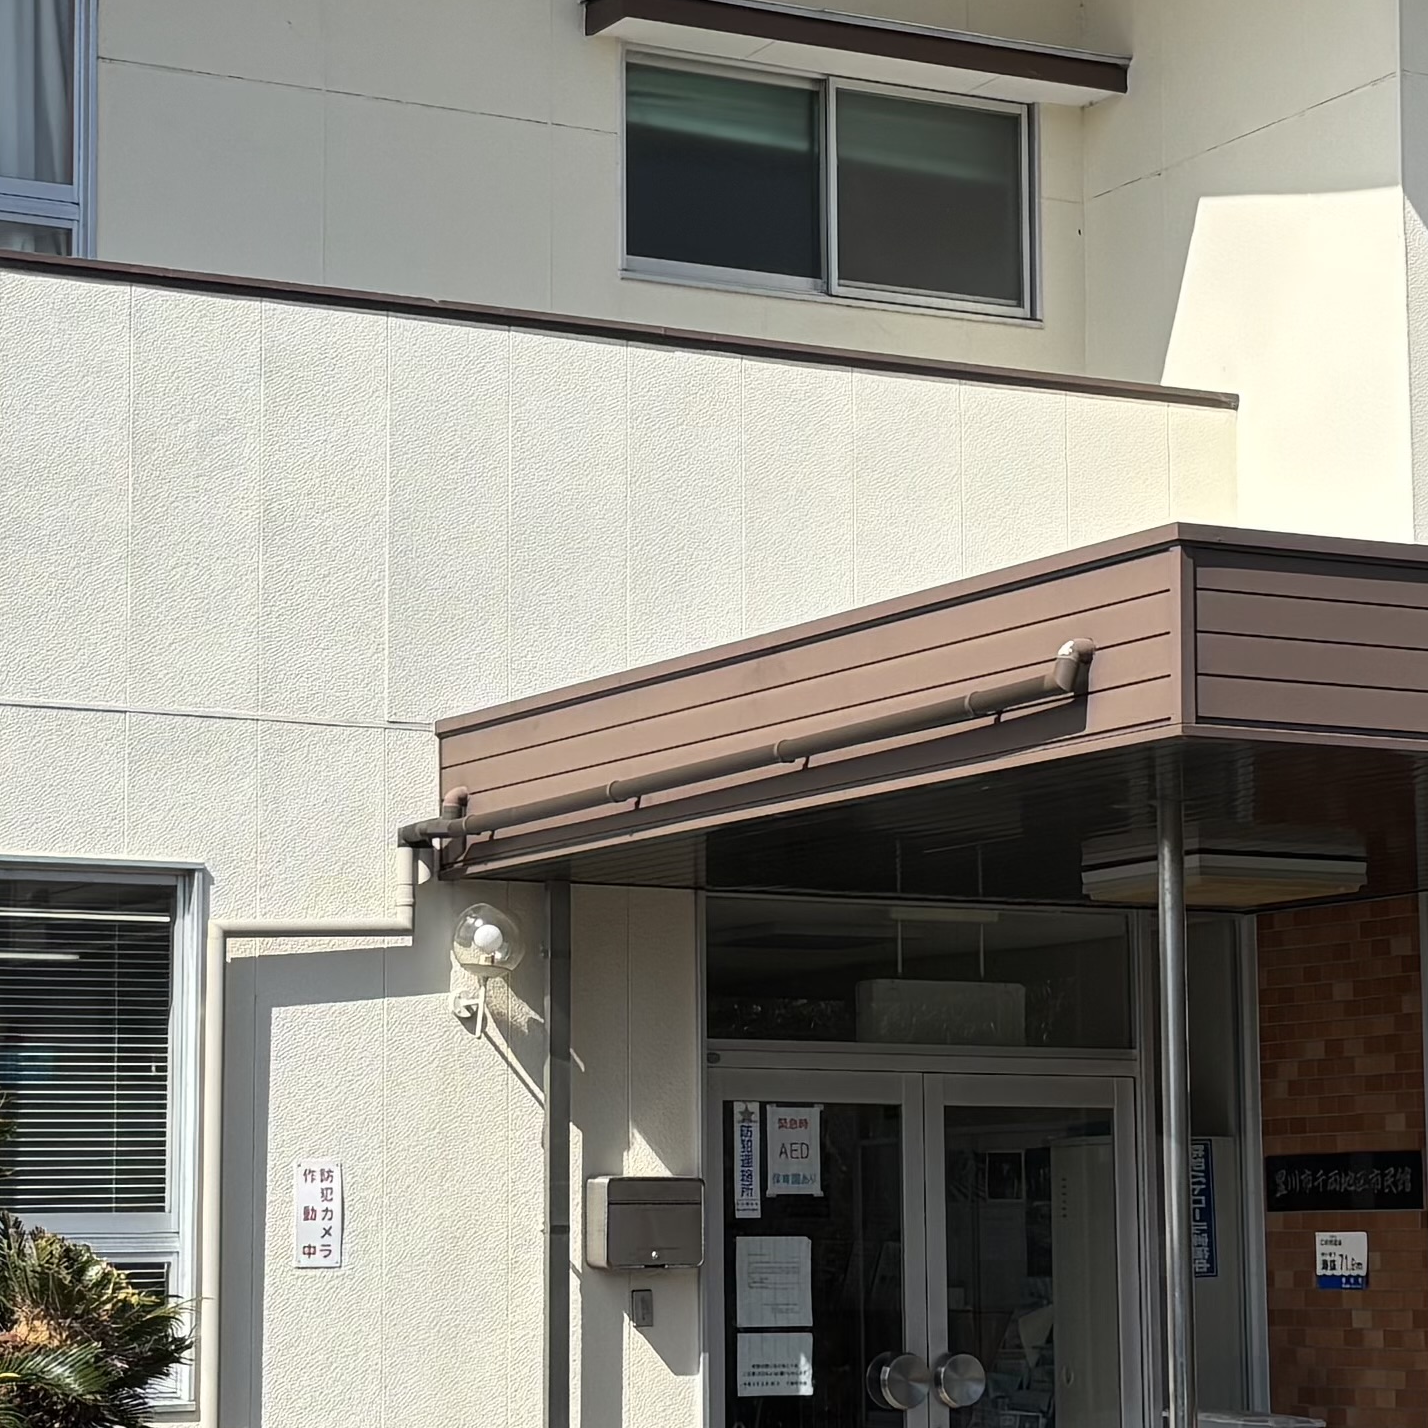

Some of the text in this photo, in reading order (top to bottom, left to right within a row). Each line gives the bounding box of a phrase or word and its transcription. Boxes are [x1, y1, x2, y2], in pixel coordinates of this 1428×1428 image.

[778, 1118, 809, 1130] 緊急時
[779, 1142, 810, 1160] AED
[1275, 1166, 1412, 1198] 豊川市千両地区市民館
[302, 1168, 317, 1259] 作動中
[319, 1168, 335, 1259] 防犯カメラ
